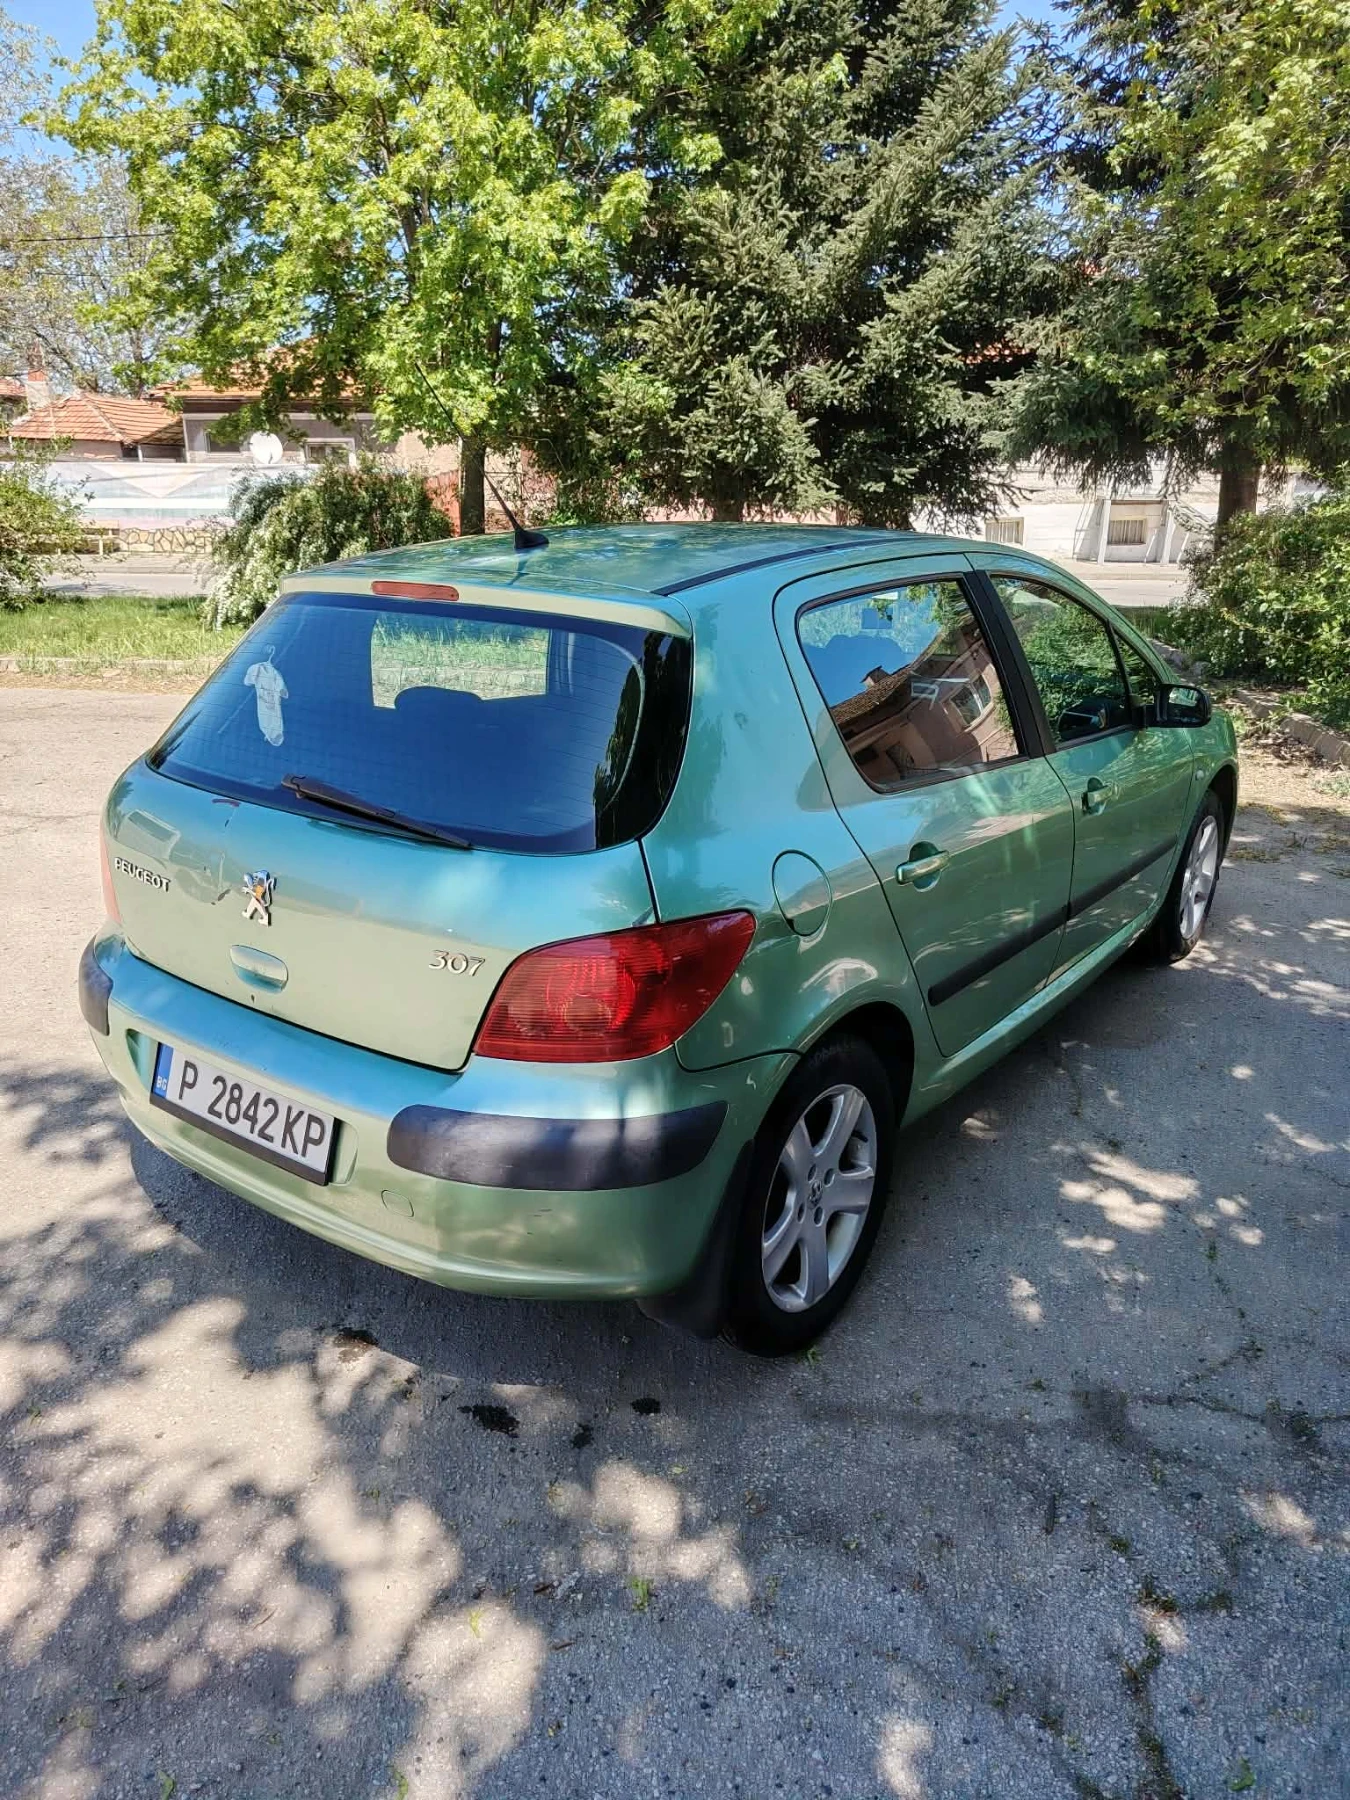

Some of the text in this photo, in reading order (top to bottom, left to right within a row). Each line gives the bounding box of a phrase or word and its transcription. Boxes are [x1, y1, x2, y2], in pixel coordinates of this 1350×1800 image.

[114, 857, 171, 892] PEUGEOT
[428, 950, 486, 977] 307
[156, 1075, 168, 1091] BG
[178, 1060, 199, 1100] P
